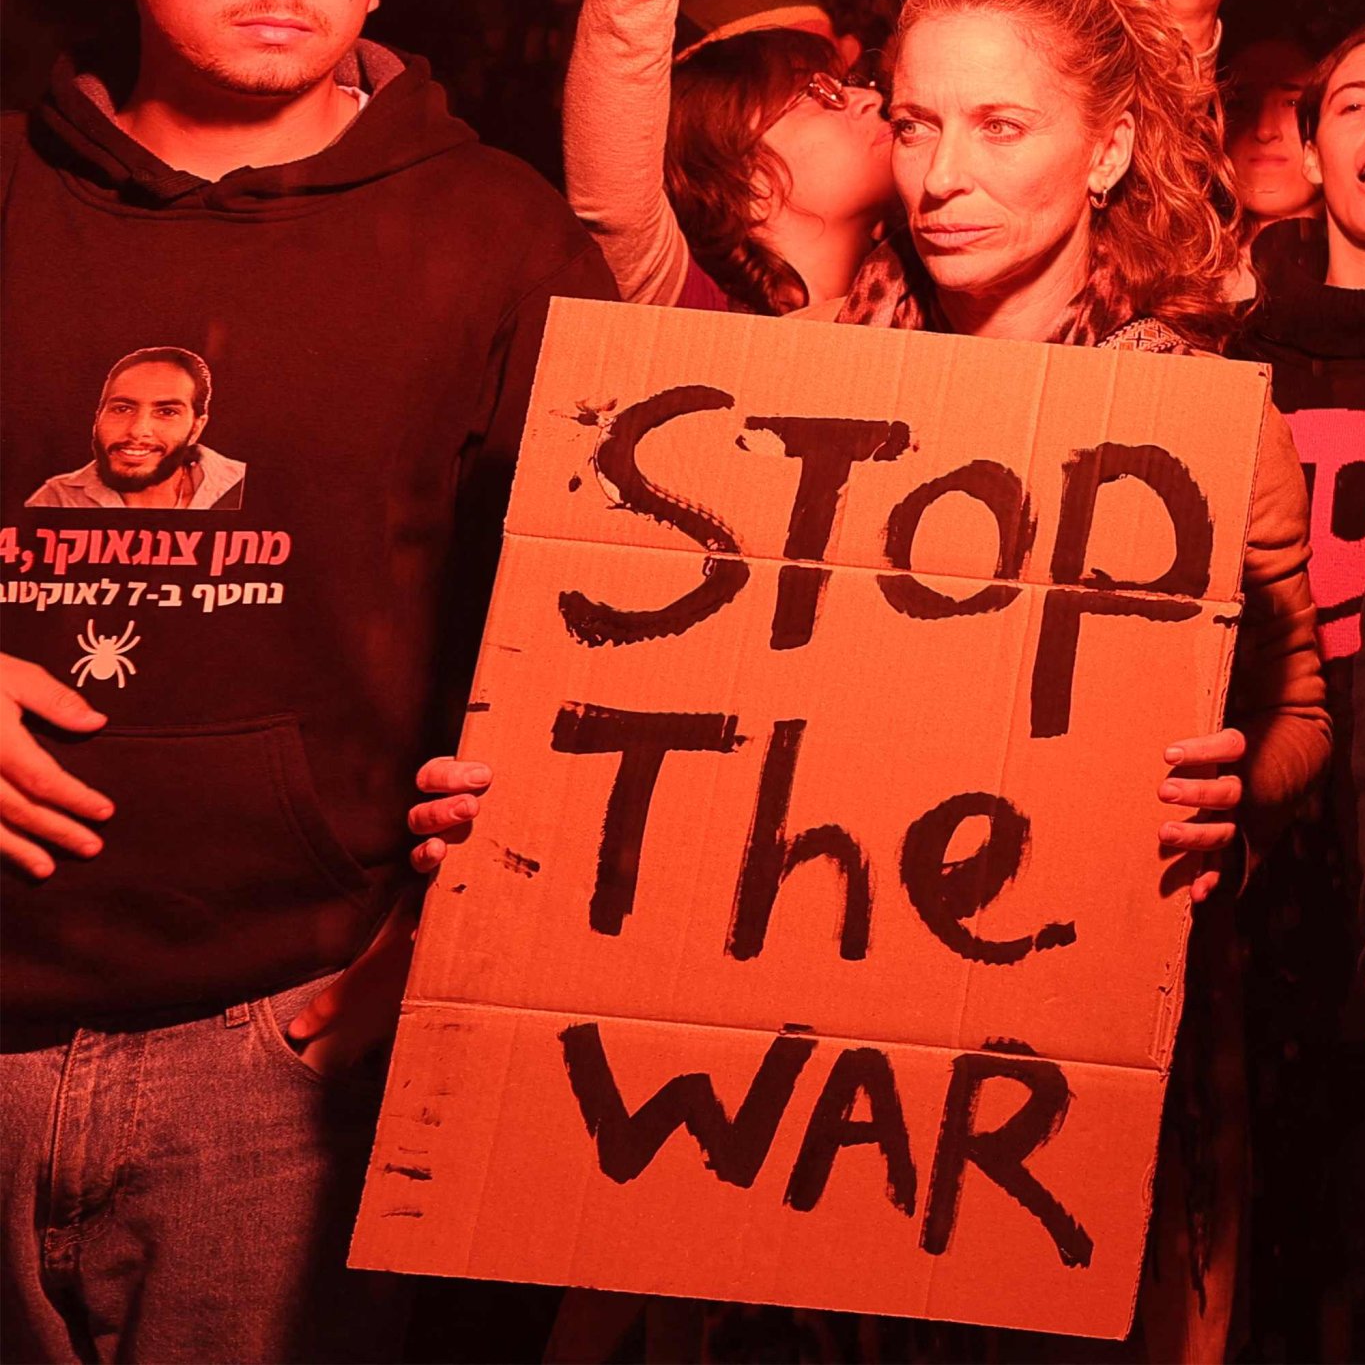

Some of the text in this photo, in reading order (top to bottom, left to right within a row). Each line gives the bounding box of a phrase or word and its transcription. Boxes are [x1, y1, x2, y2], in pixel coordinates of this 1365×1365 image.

[209, 530, 291, 577] מתן
[127, 580, 183, 608] ב-7
[191, 582, 285, 614] נחטף
[550, 700, 1077, 966] The
[557, 1022, 1096, 1270] WAR
